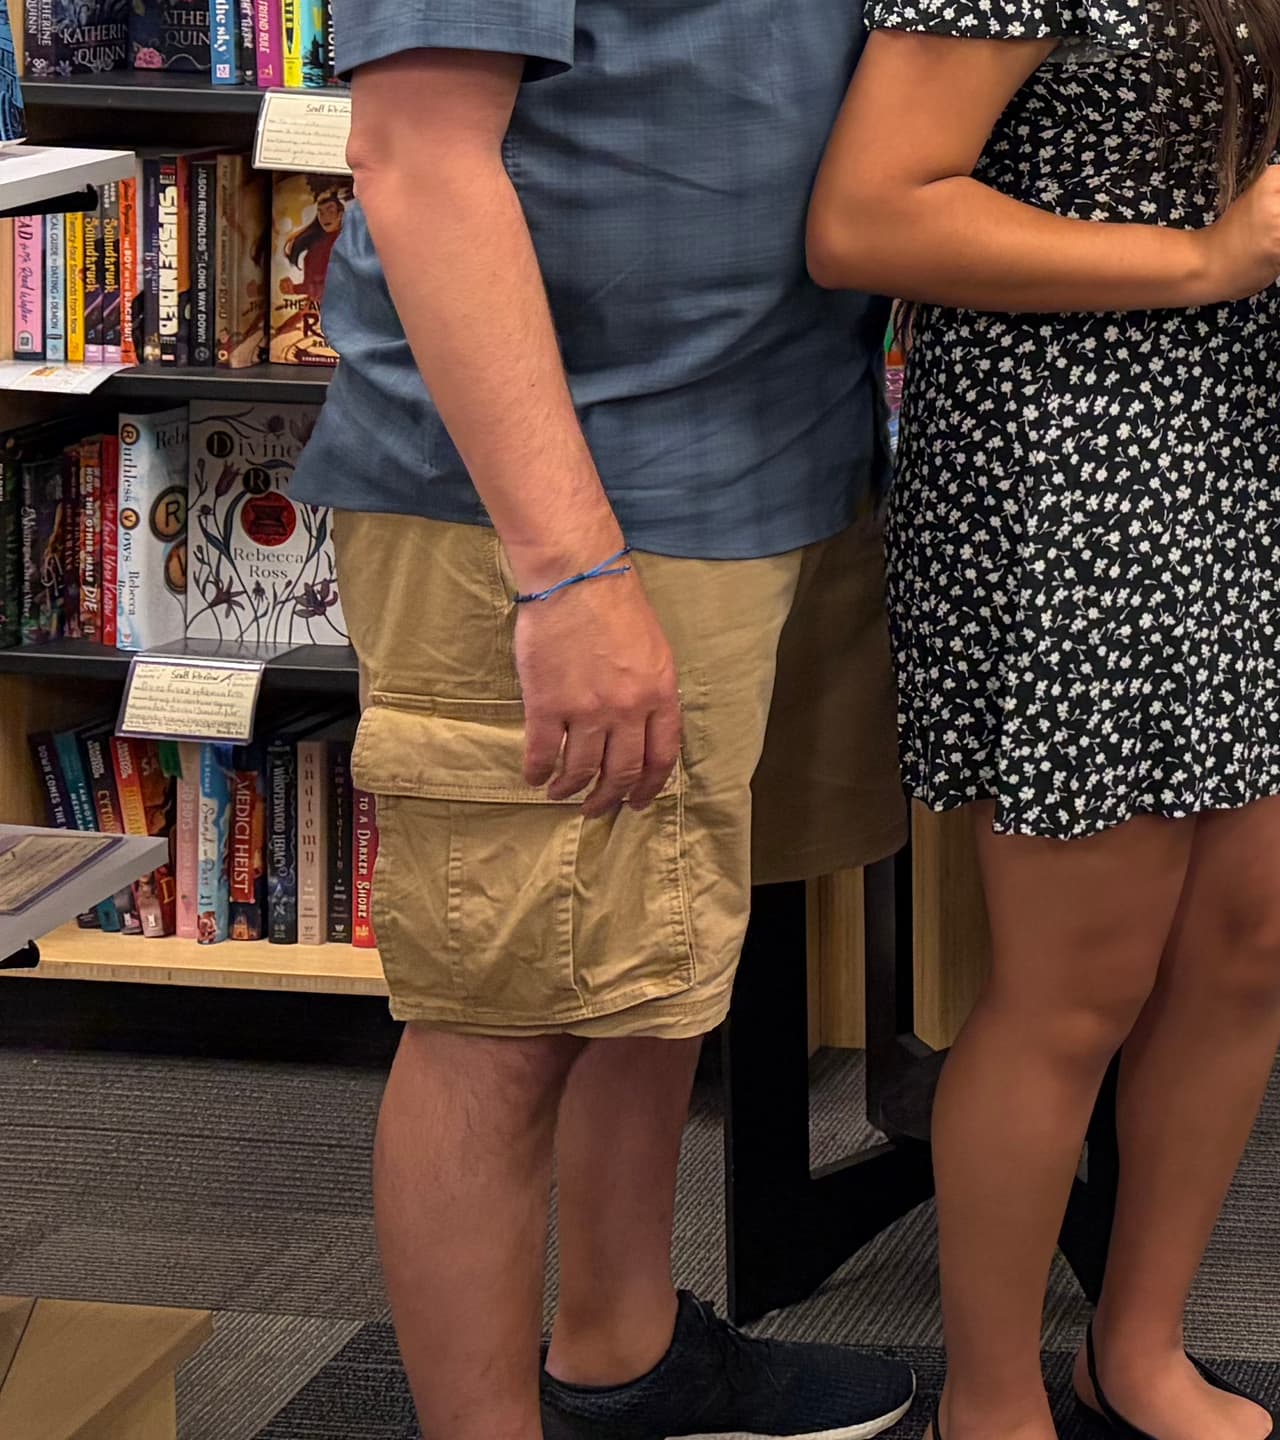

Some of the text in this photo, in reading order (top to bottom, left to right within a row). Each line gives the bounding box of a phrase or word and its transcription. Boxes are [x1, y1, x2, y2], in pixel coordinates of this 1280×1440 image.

[198, 312, 206, 343] DOWN
[120, 422, 140, 562] Ruthless Vows
[233, 547, 304, 565] Rebecca
[250, 564, 288, 580] Ross
[234, 780, 250, 893] MEDICI HEIST
